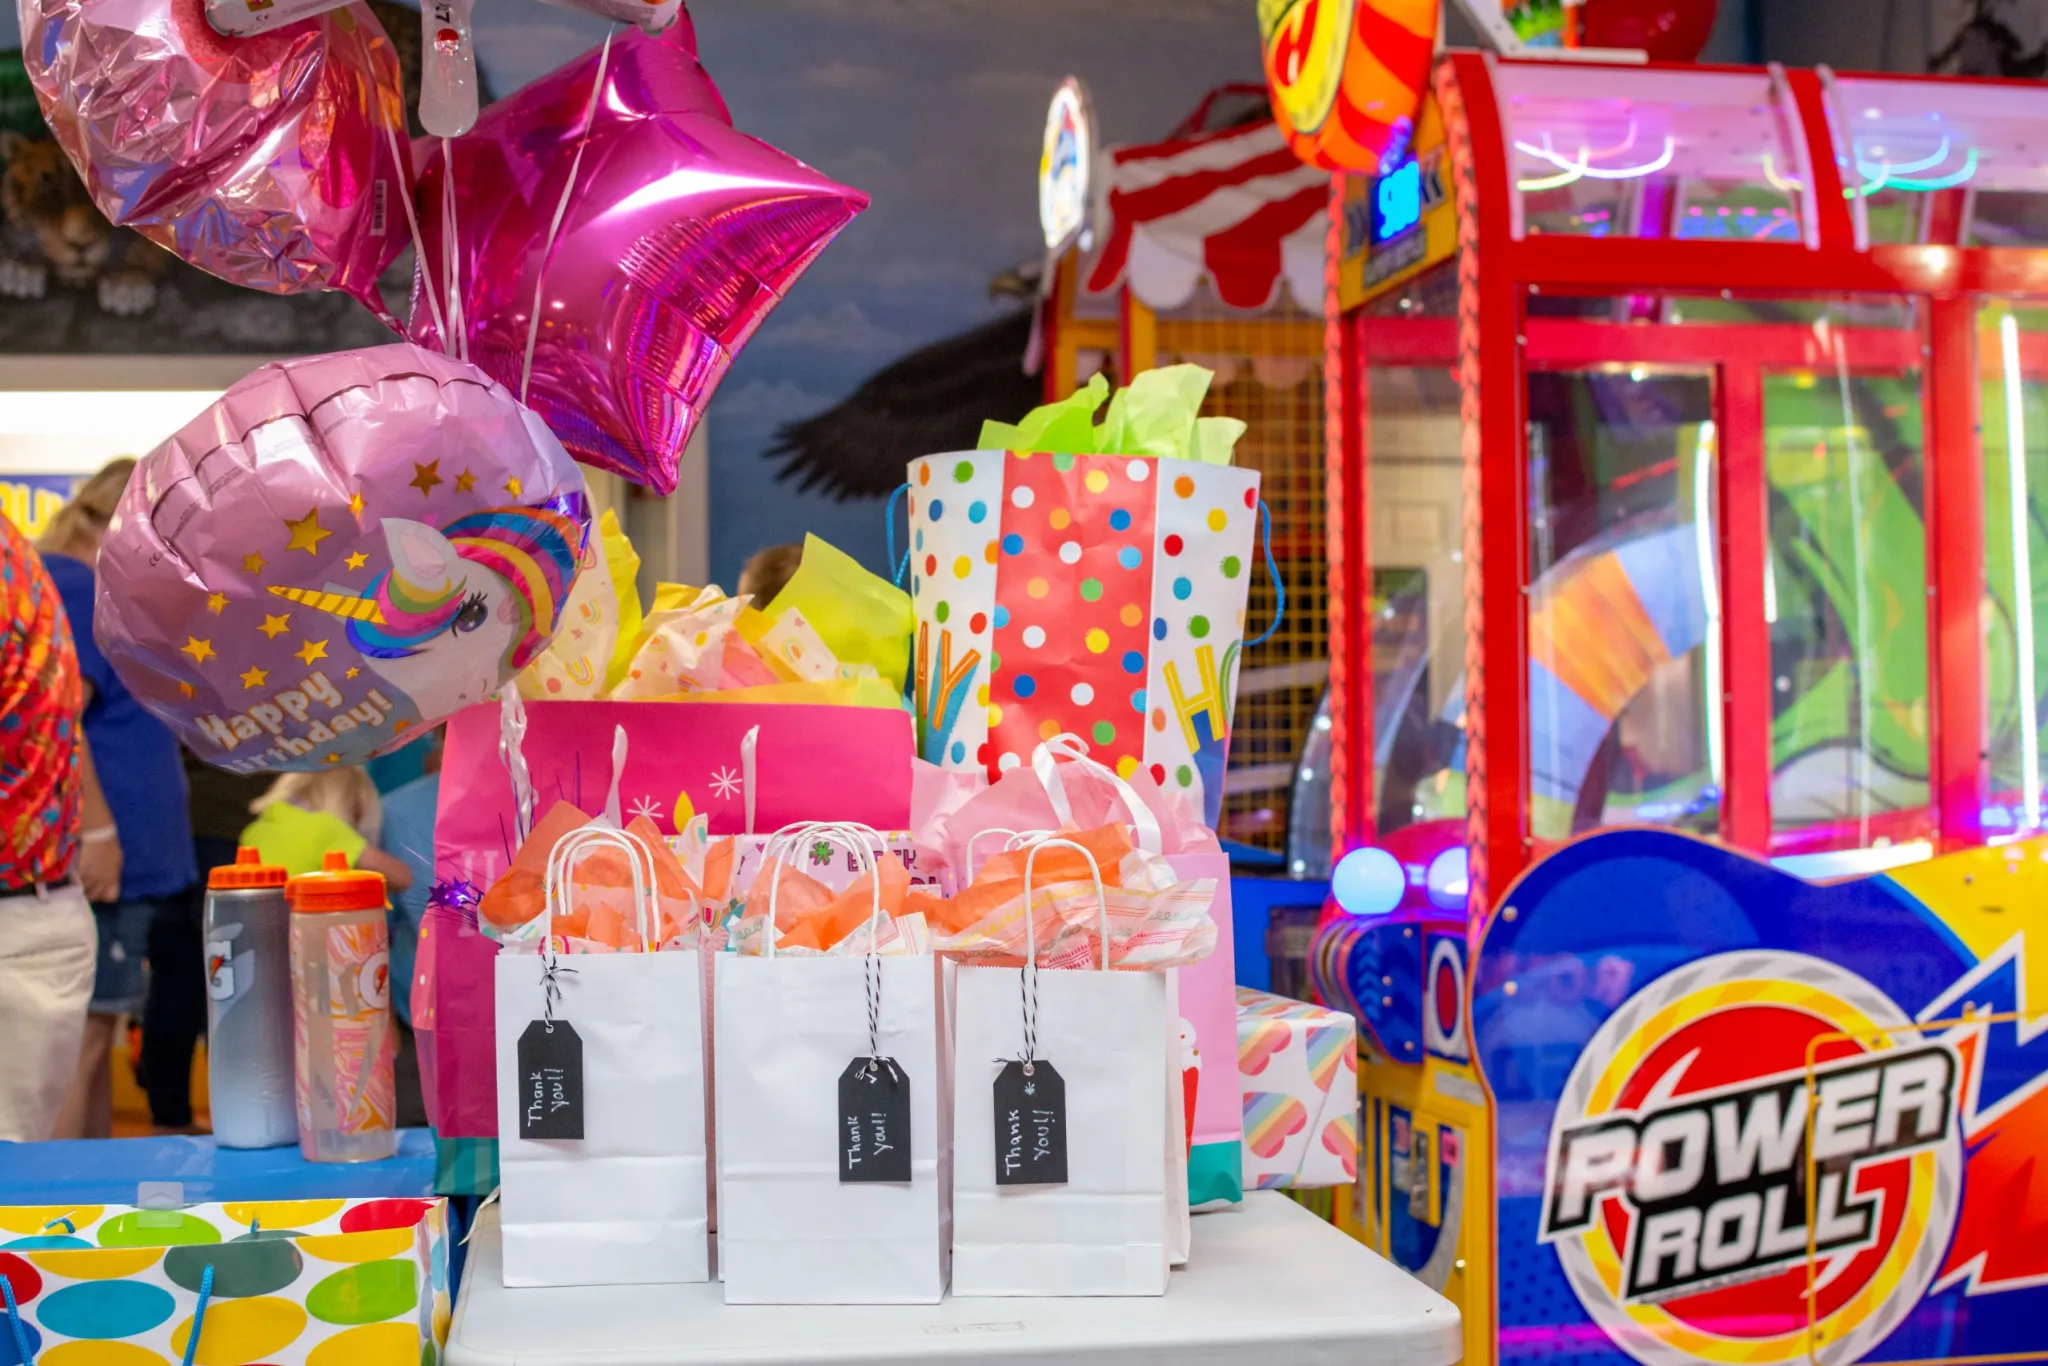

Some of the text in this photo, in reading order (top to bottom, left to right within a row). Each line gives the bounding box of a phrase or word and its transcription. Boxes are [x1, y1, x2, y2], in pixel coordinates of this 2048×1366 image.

[193, 671, 343, 752] Happy
[215, 688, 393, 773] irthday!
[527, 1071, 544, 1128] Thank
[1557, 1054, 1950, 1223] POWER
[846, 1115, 862, 1170] Thank
[1005, 1109, 1023, 1176] Thank
[1635, 1172, 1867, 1288] ROLL
